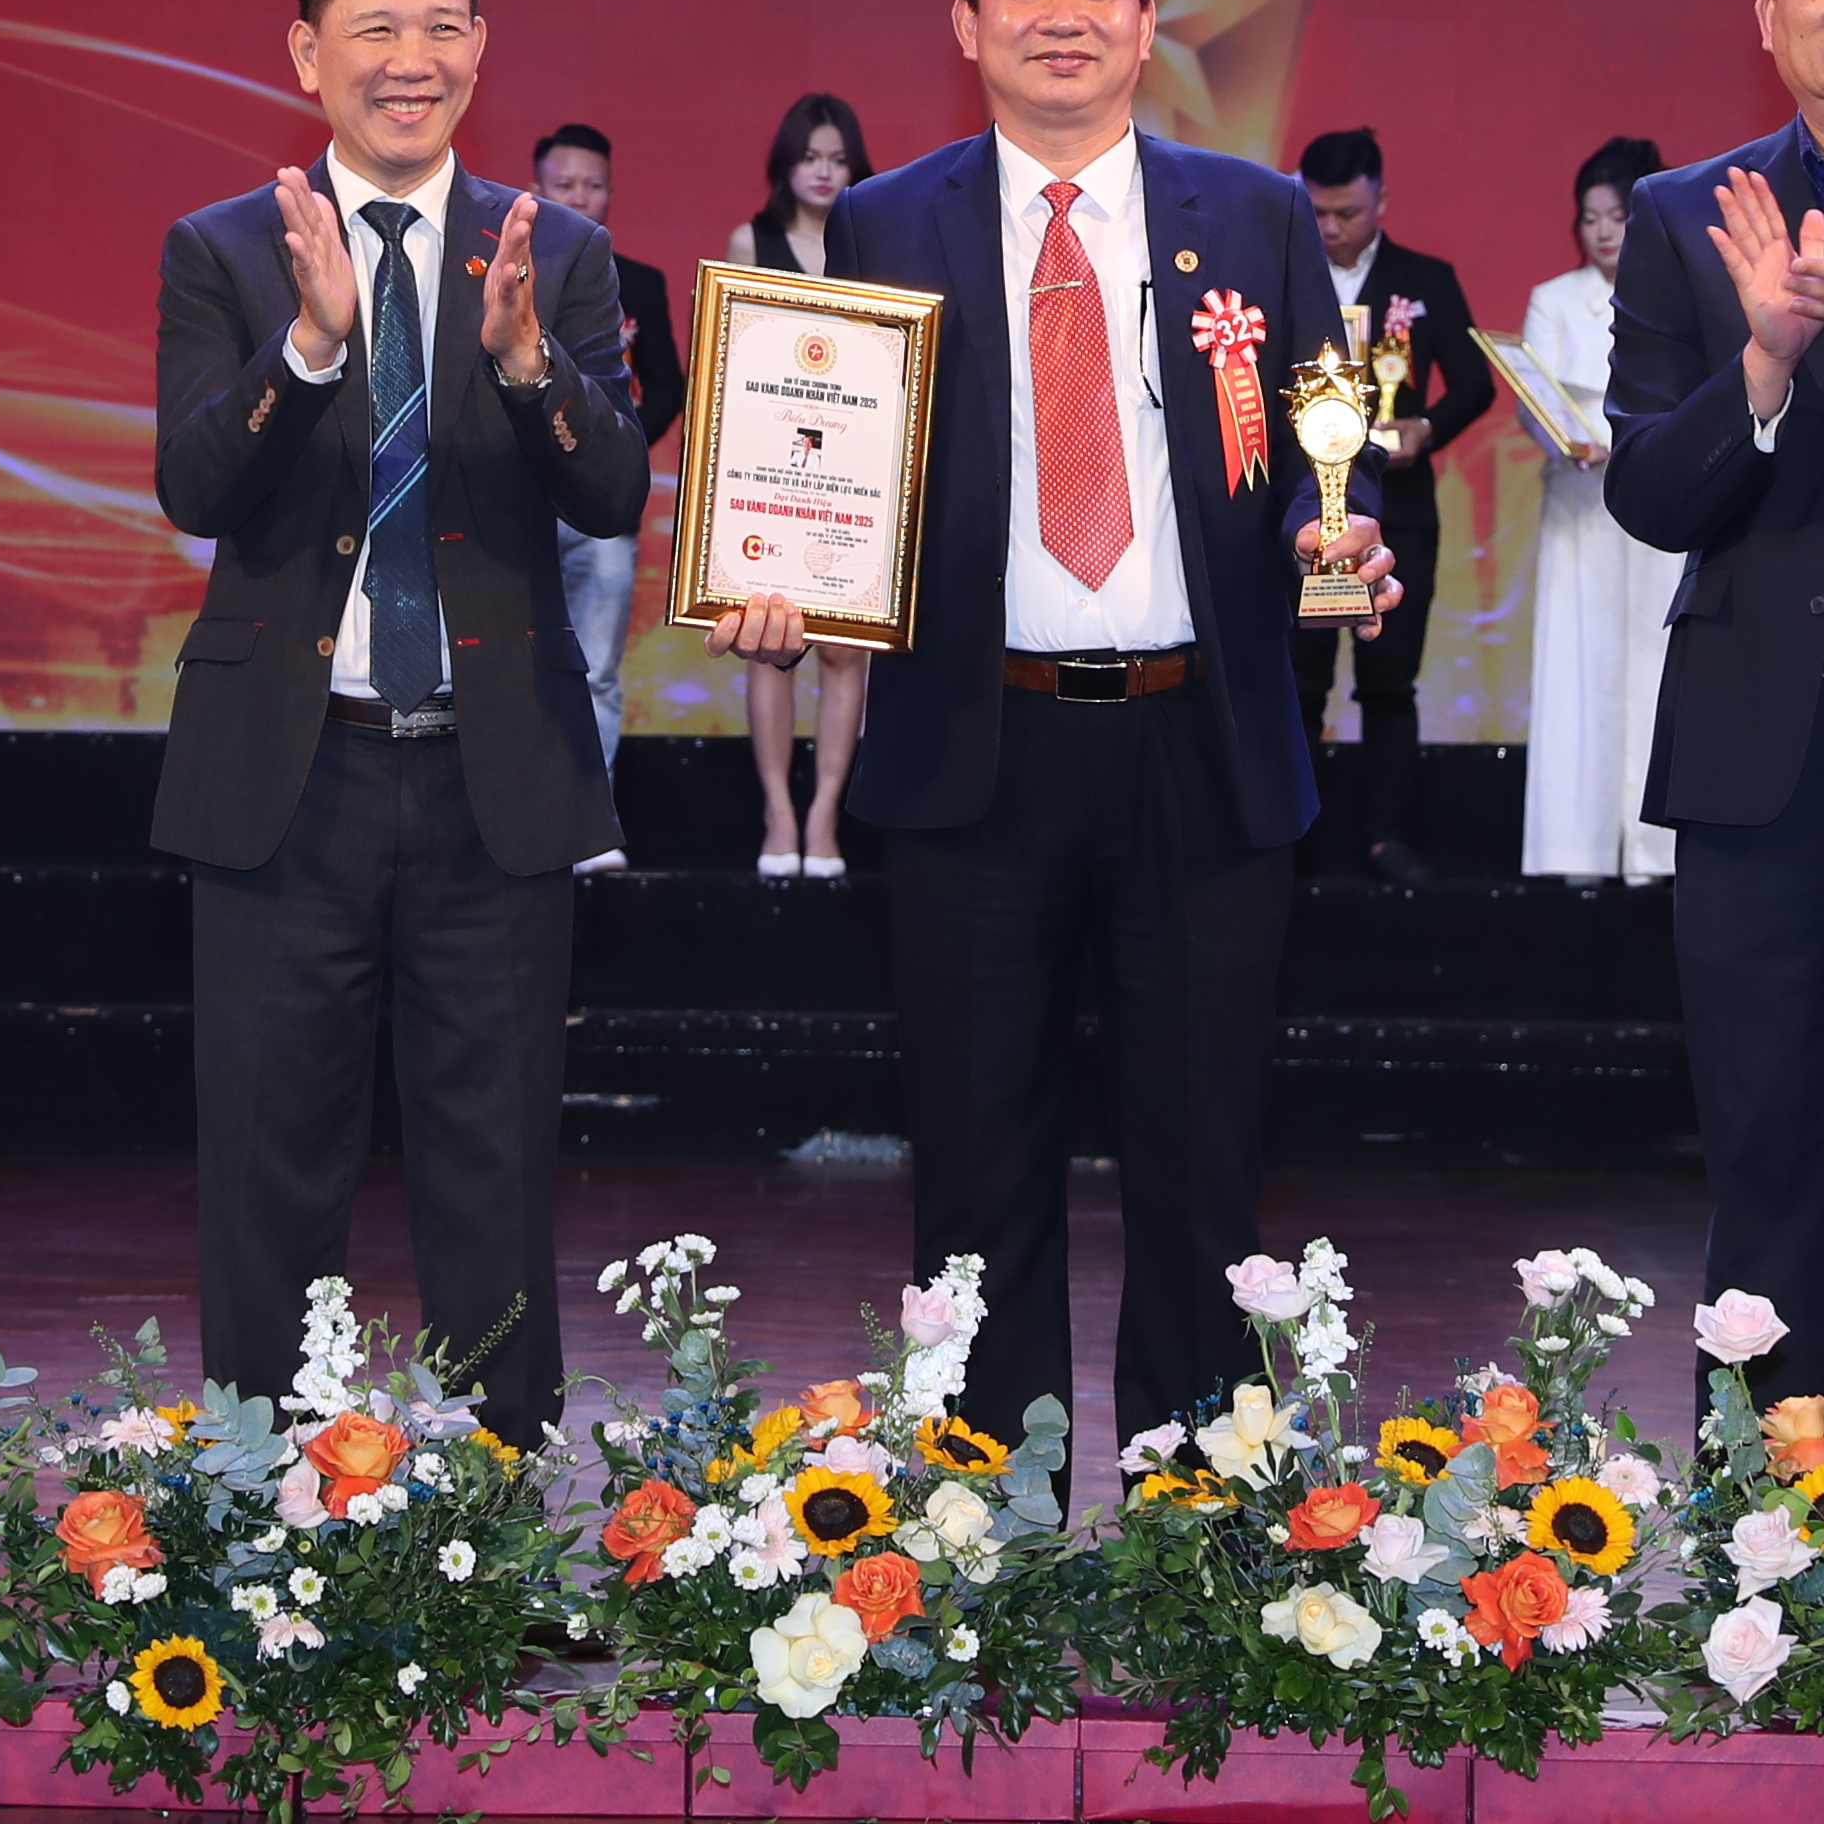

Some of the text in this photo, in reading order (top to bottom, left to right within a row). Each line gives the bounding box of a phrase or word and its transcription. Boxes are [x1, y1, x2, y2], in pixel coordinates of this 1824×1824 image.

[1216, 314, 1253, 346] 32
[745, 380, 759, 392] SAO
[761, 382, 779, 395] VÀNG
[842, 394, 858, 406] NAM
[860, 396, 878, 409] 2025
[730, 498, 873, 527] SAO VÀNG DOANH NHÂN VIỆT NAM 2025
